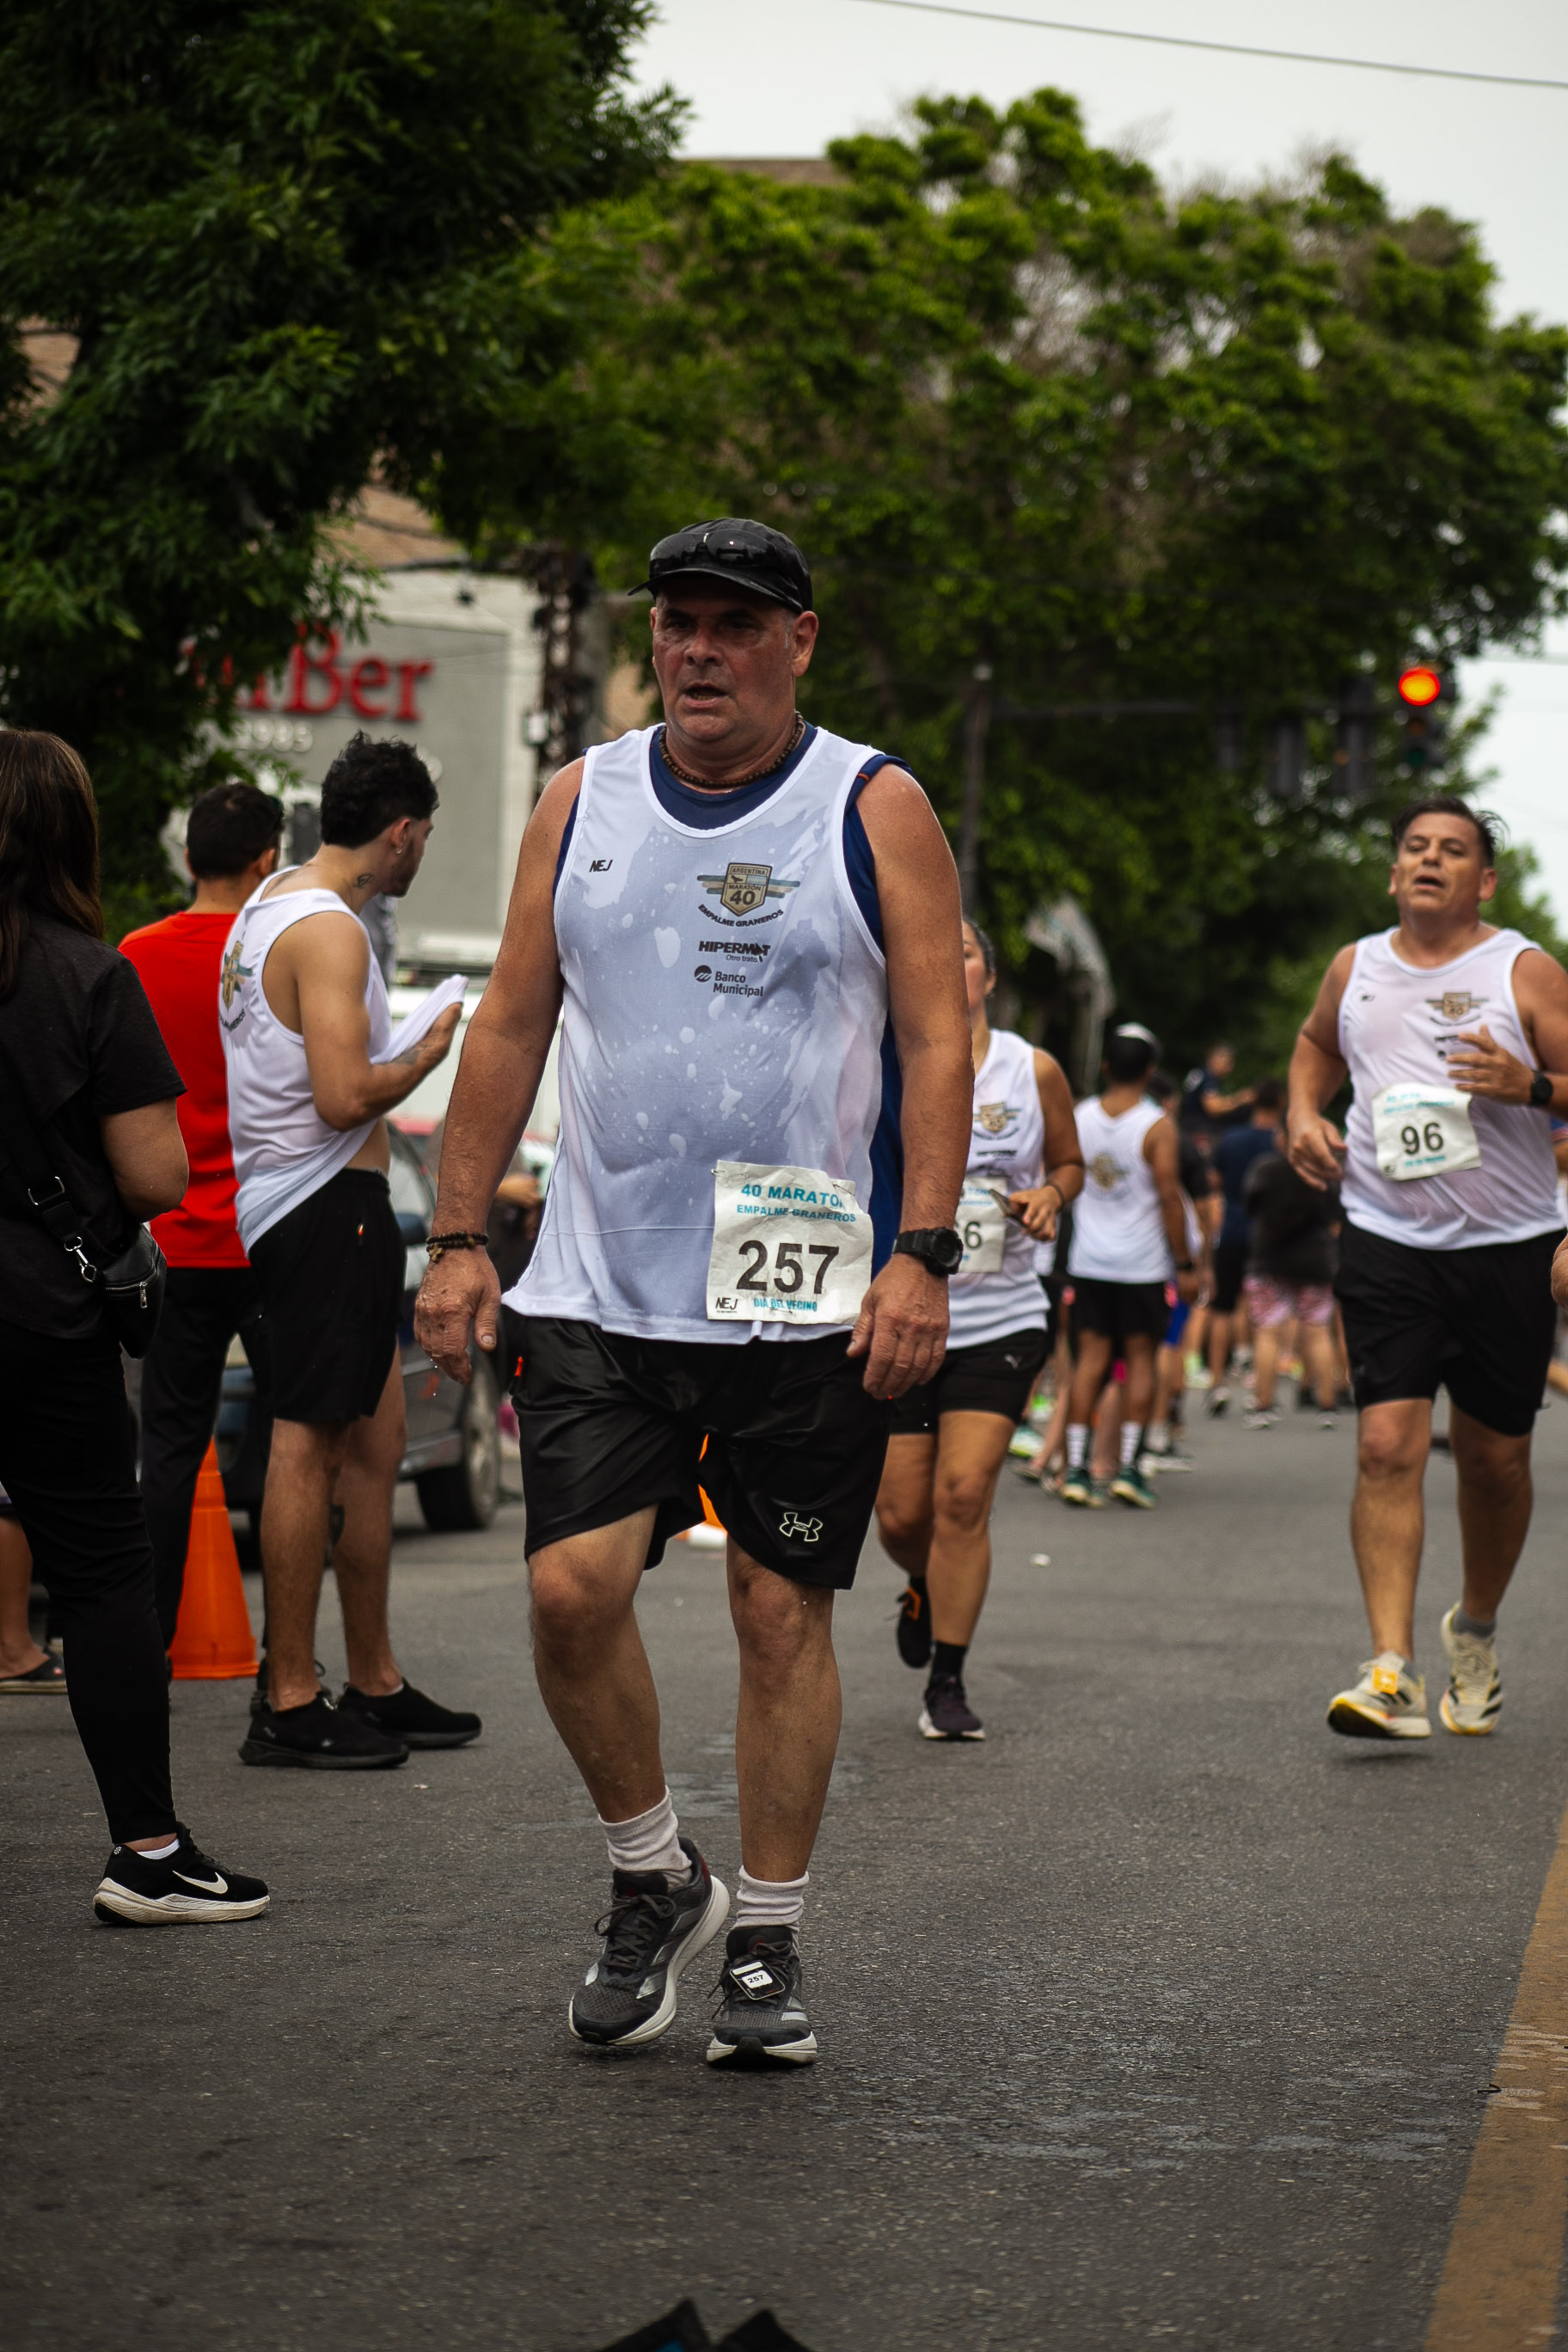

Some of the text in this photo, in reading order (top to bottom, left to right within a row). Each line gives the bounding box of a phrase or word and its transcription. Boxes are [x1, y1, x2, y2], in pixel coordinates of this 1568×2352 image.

[589, 860, 614, 873] NEJ
[732, 867, 766, 876] ARGENTINA
[729, 890, 756, 905] 40
[698, 903, 785, 928] EMPALME GRANEROS
[714, 971, 746, 983] Banco
[713, 983, 764, 998] Municipal
[1400, 1122, 1444, 1155] 96
[741, 1184, 763, 1197] 40
[737, 1204, 856, 1222] EMPALME GRANEROS
[736, 1240, 840, 1295] 257
[715, 1296, 738, 1310] NEJ
[753, 1297, 769, 1308] DIA
[786, 1300, 818, 1312] VECINO
[747, 1974, 764, 1984] 257
